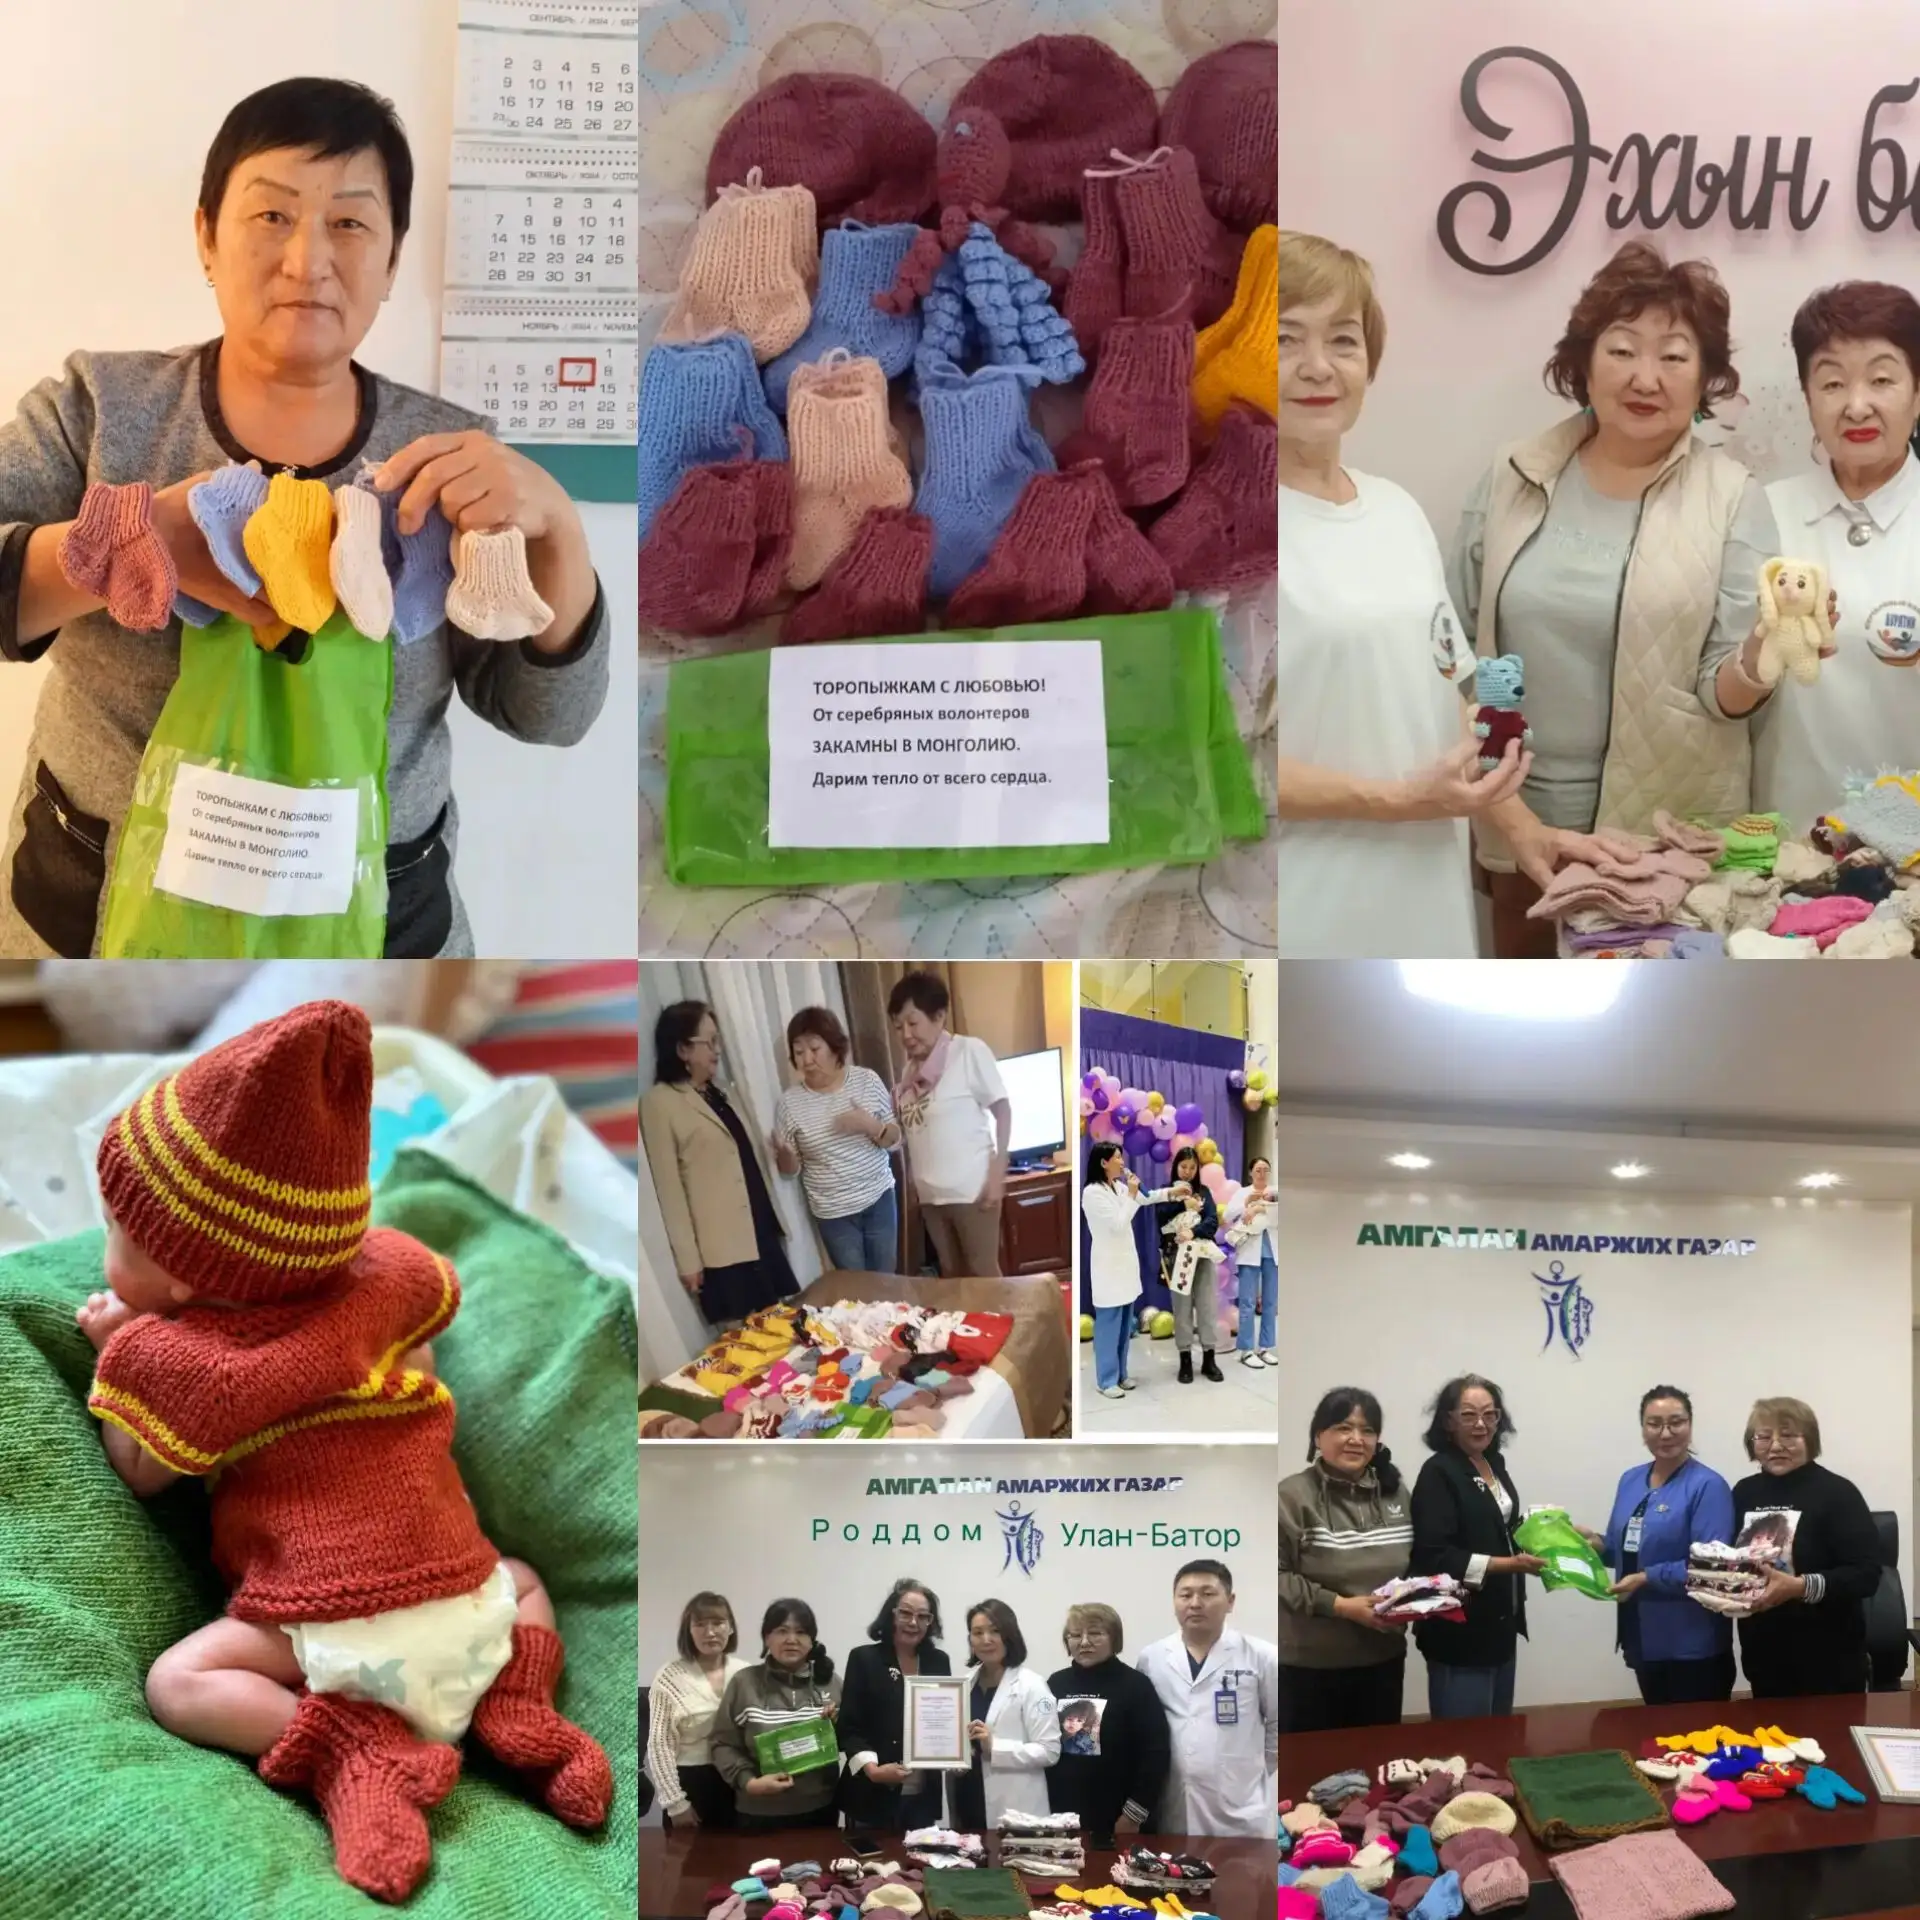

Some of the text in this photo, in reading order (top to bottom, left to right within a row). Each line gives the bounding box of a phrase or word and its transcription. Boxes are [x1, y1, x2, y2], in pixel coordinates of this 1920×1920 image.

[504, 57, 630, 75] 2 3 4 5 6
[503, 77, 634, 94] 9 10 11 12 13
[499, 96, 633, 112] 16 17 18 19 20
[526, 116, 543, 128] 24
[554, 118, 572, 130] 25
[584, 119, 602, 130] 26
[613, 119, 632, 131] 27
[1436, 45, 1830, 276] Эхын
[526, 197, 622, 209] 1 2 3 4
[495, 214, 624, 228] 7 8 9 10 11
[491, 233, 625, 247] 14 15 16 17 18
[489, 252, 623, 265] 21 22 23 24 25
[488, 269, 591, 283] 28 29 30 31
[606, 348, 612, 359] 1
[487, 364, 613, 376] 4 5 6 7 8
[485, 382, 638, 394] 11 12 13 14 15 1
[483, 399, 638, 412] 18 19 20 21 22 2
[509, 417, 527, 428] 26
[538, 417, 556, 428] 27
[567, 418, 586, 429] 28
[596, 418, 615, 429] 29
[813, 679, 1046, 695] ТОРОПЫЖКАМ С ЛЮБОВЬЮ!
[813, 706, 1030, 724] От серебряных волонтеров
[813, 737, 1021, 754] ЗАКАМНЫ В МОНГОЛИЮ.
[812, 771, 1052, 788] Дарим тепло от всего сердца.
[196, 790, 332, 823] ТОРОПЫЖКАМ С ЛЮБОВЬЮ!
[192, 807, 320, 839] От серебряных волонтеров
[188, 827, 237, 848] ЗАКАМНЫ
[239, 840, 246, 850] В
[184, 848, 215, 864] Дарим
[217, 858, 247, 872] тепло
[248, 865, 259, 875] от
[261, 868, 288, 879] всего
[1356, 1223, 1757, 1257] АМГАЛАН АМАРЖИХ ГАЗАР
[866, 1476, 1184, 1496] АМГАЛАН АМАРЖИХ ГАЗАР
